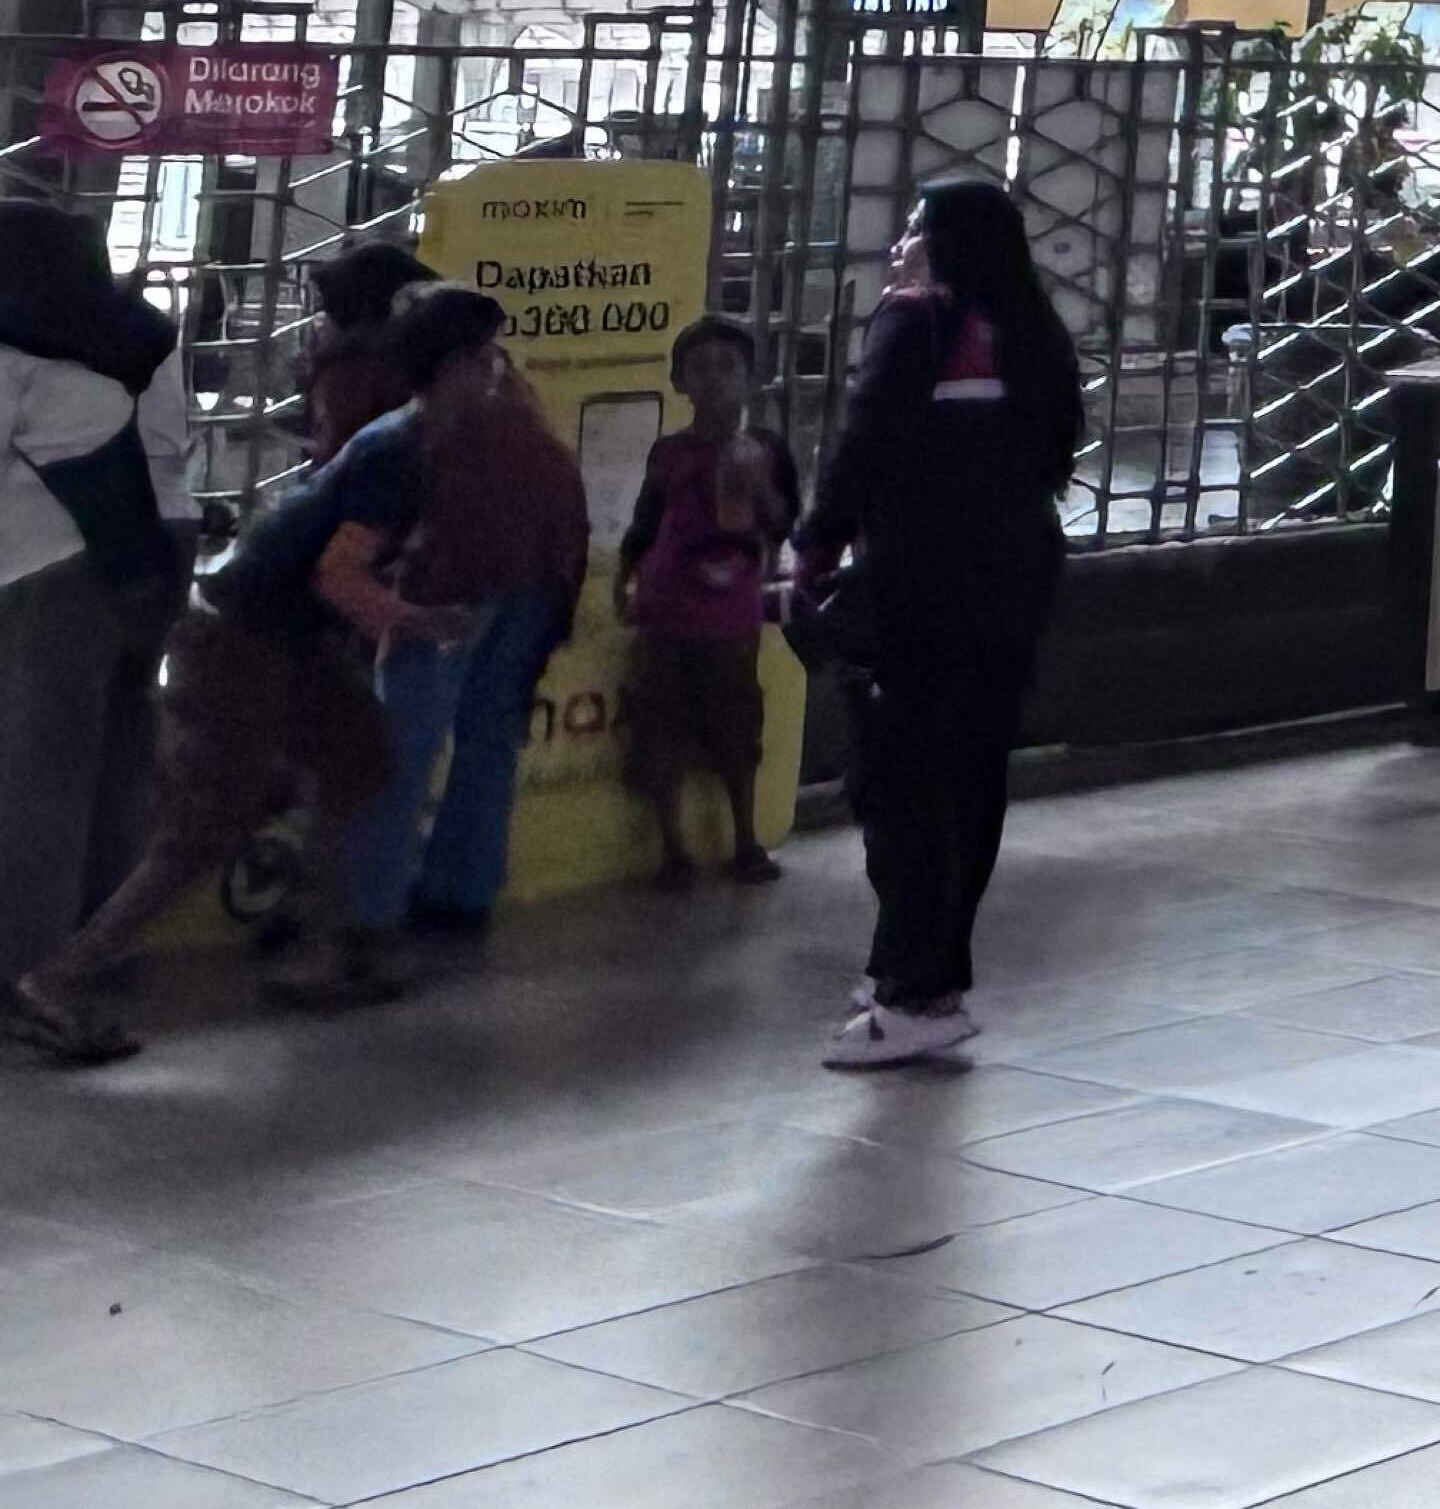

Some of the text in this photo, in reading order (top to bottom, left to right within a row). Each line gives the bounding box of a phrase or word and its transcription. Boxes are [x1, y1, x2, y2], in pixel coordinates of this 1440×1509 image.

[189, 55, 321, 89] Dilarang
[184, 88, 317, 115] Merokok
[476, 256, 652, 293] Dapatkan
